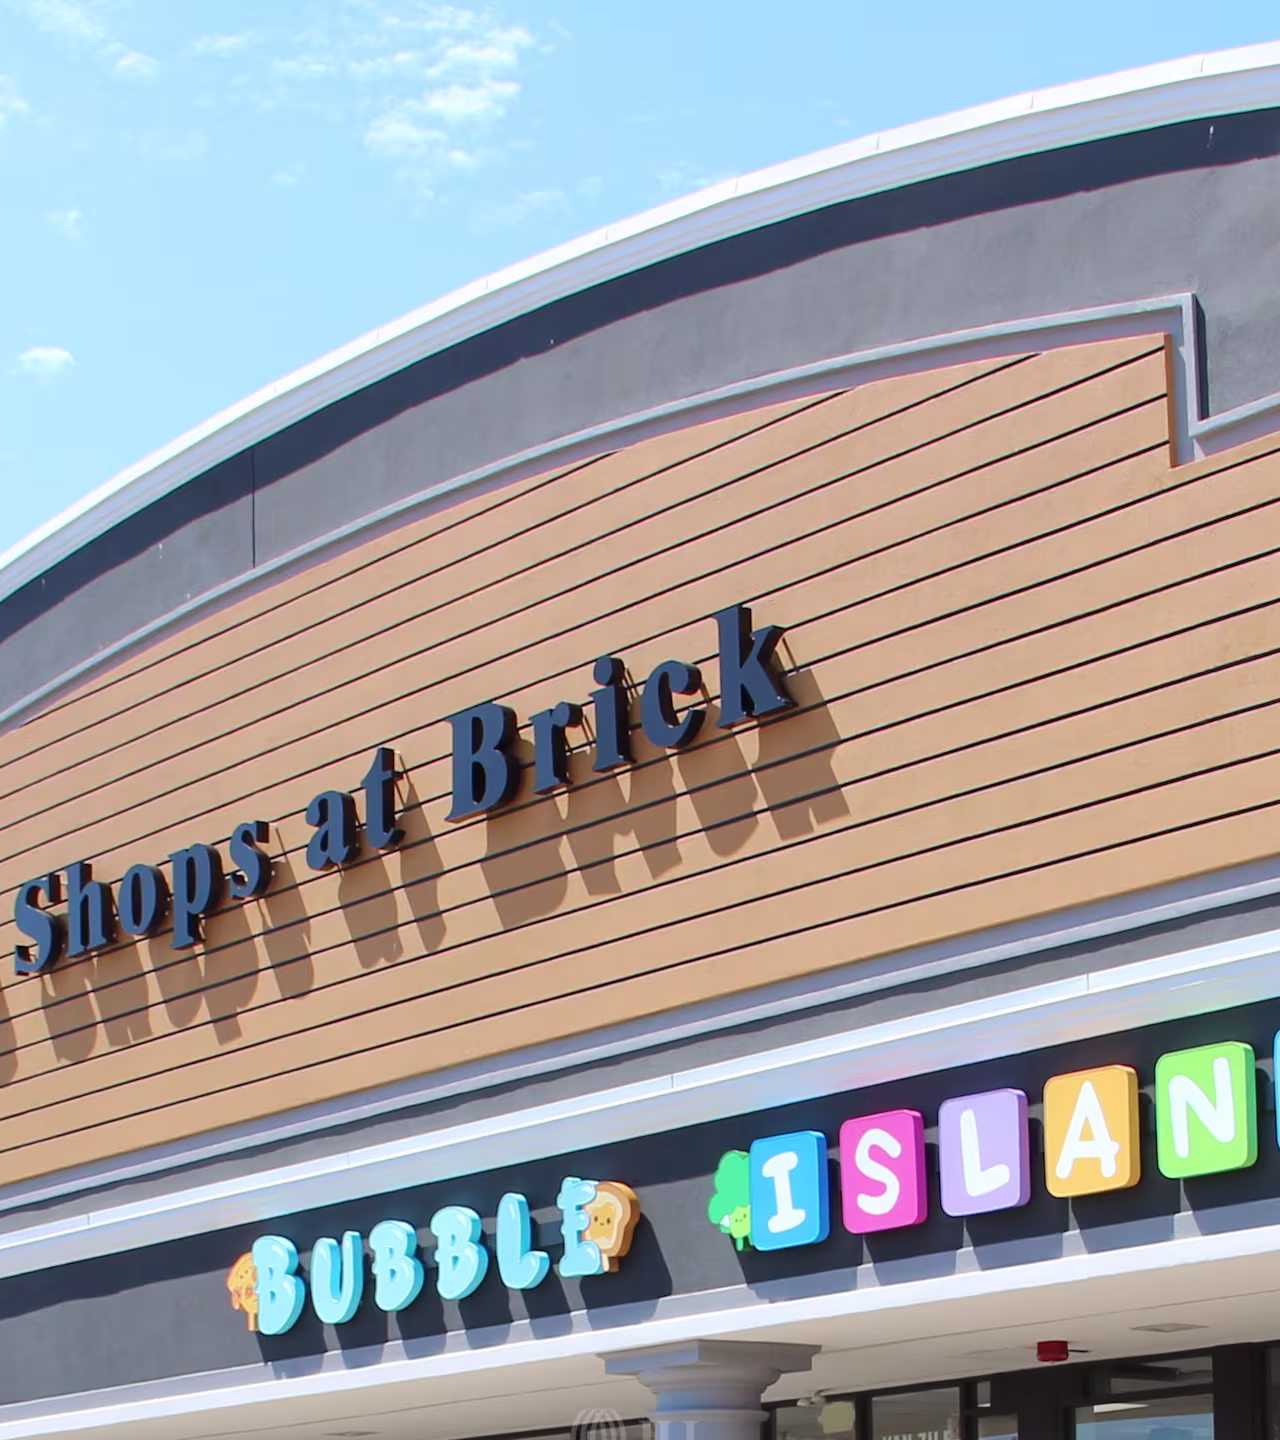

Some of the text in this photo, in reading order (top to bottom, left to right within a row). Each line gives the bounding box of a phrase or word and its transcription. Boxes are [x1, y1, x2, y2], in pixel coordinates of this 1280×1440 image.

[13, 817, 274, 978] Shops
[304, 746, 406, 872] at
[444, 602, 798, 823] Brick
[250, 1176, 608, 1337] BUBBLE
